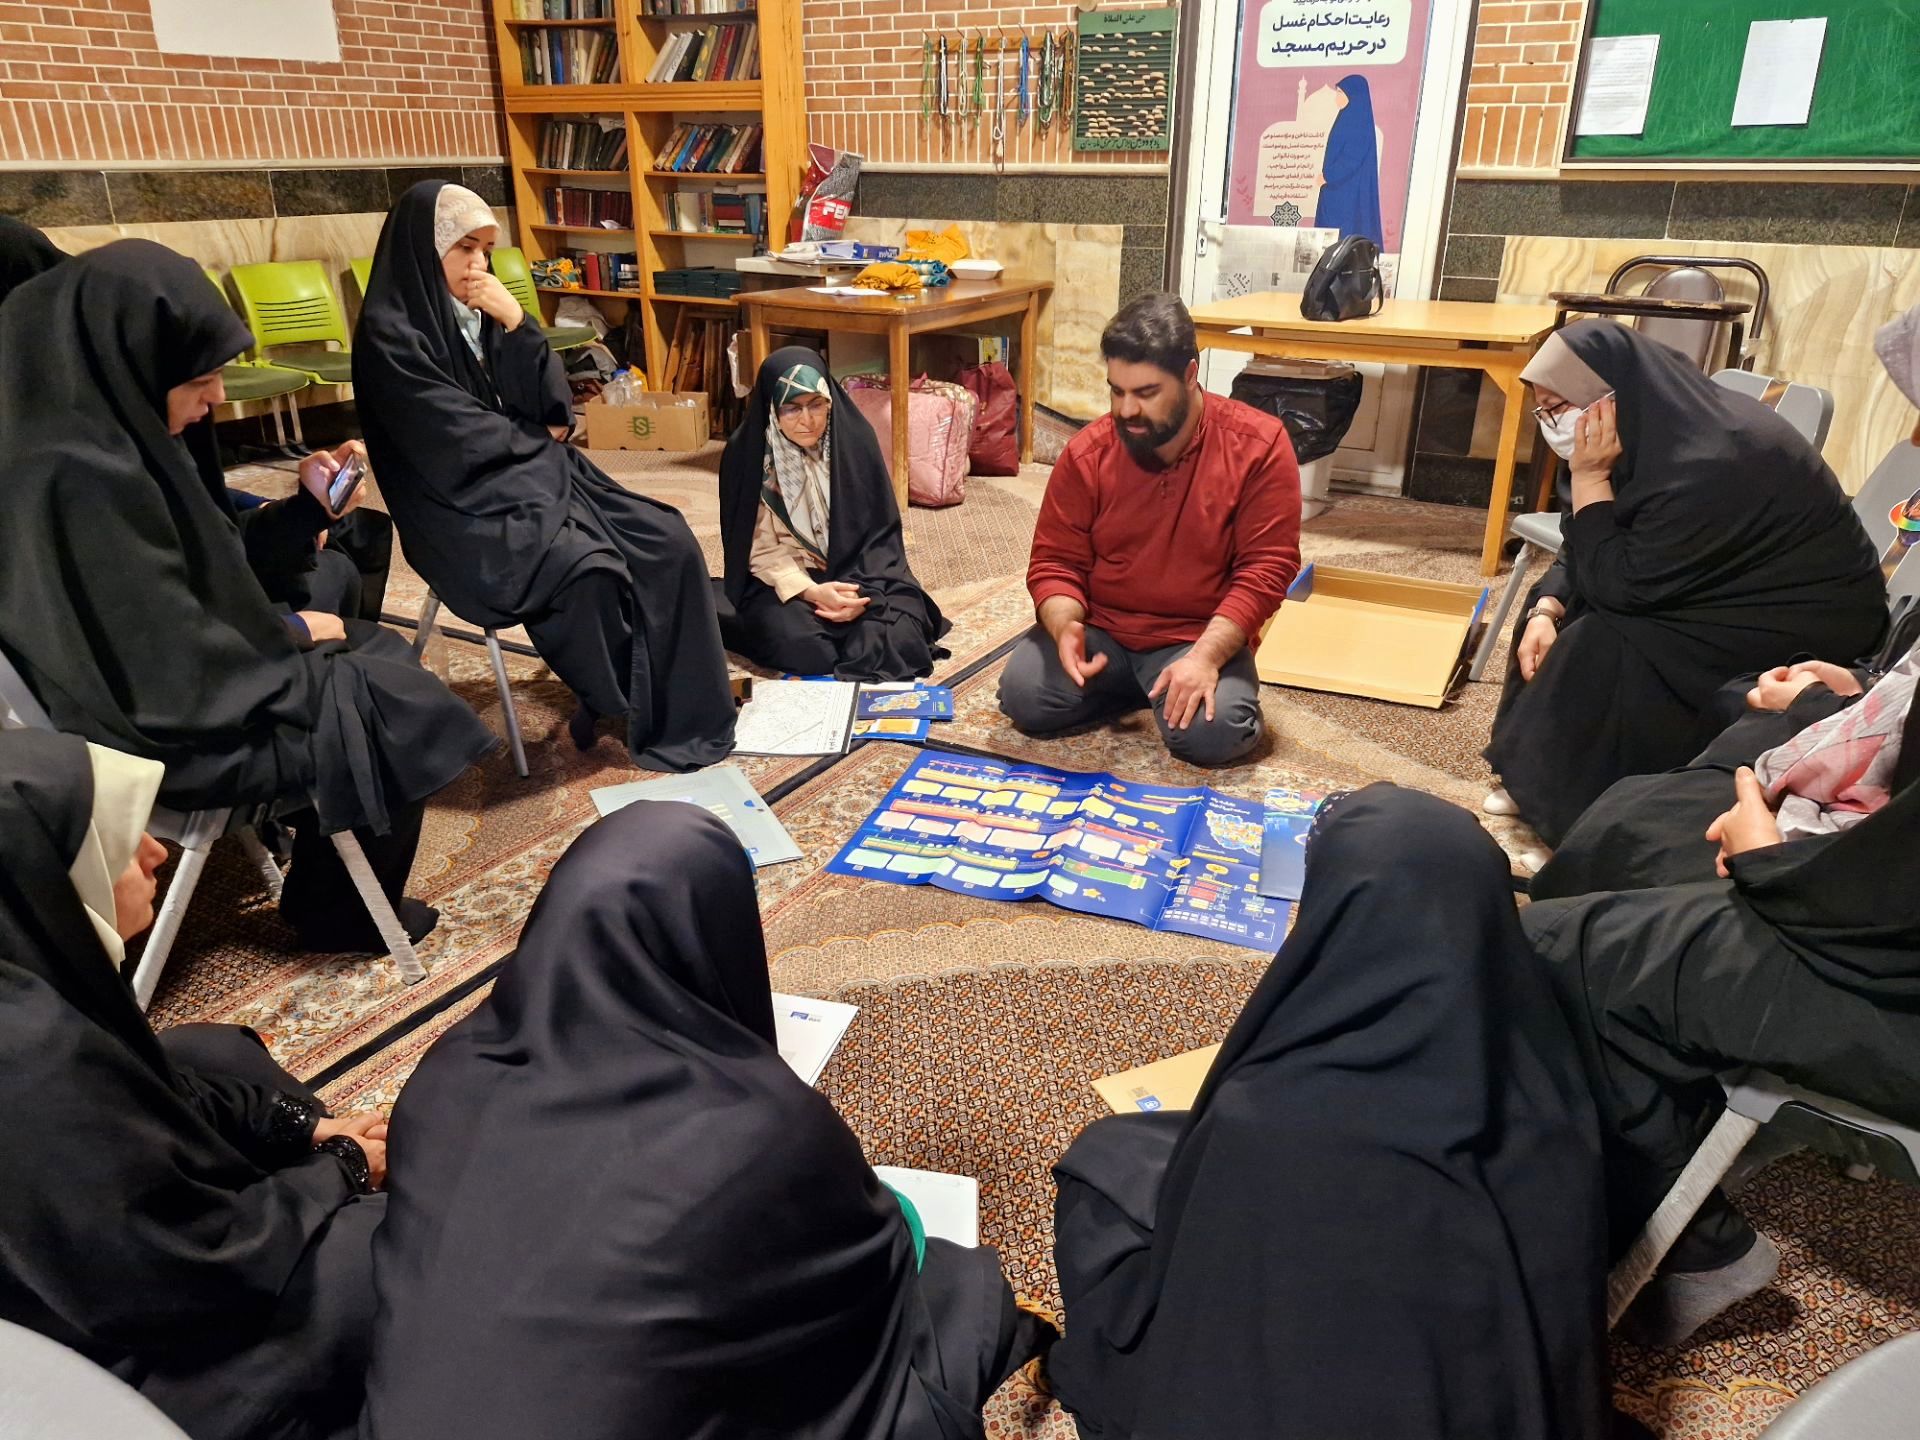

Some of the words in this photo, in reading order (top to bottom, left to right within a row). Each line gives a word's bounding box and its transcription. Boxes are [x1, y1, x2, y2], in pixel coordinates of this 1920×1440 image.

[1272, 13, 1307, 31] غسل
[1307, 12, 1349, 32] احکام
[1349, 11, 1390, 28] رعایت
[1271, 40, 1325, 57] مسجد
[1325, 40, 1369, 57] حریم
[1367, 37, 1387, 55] در
